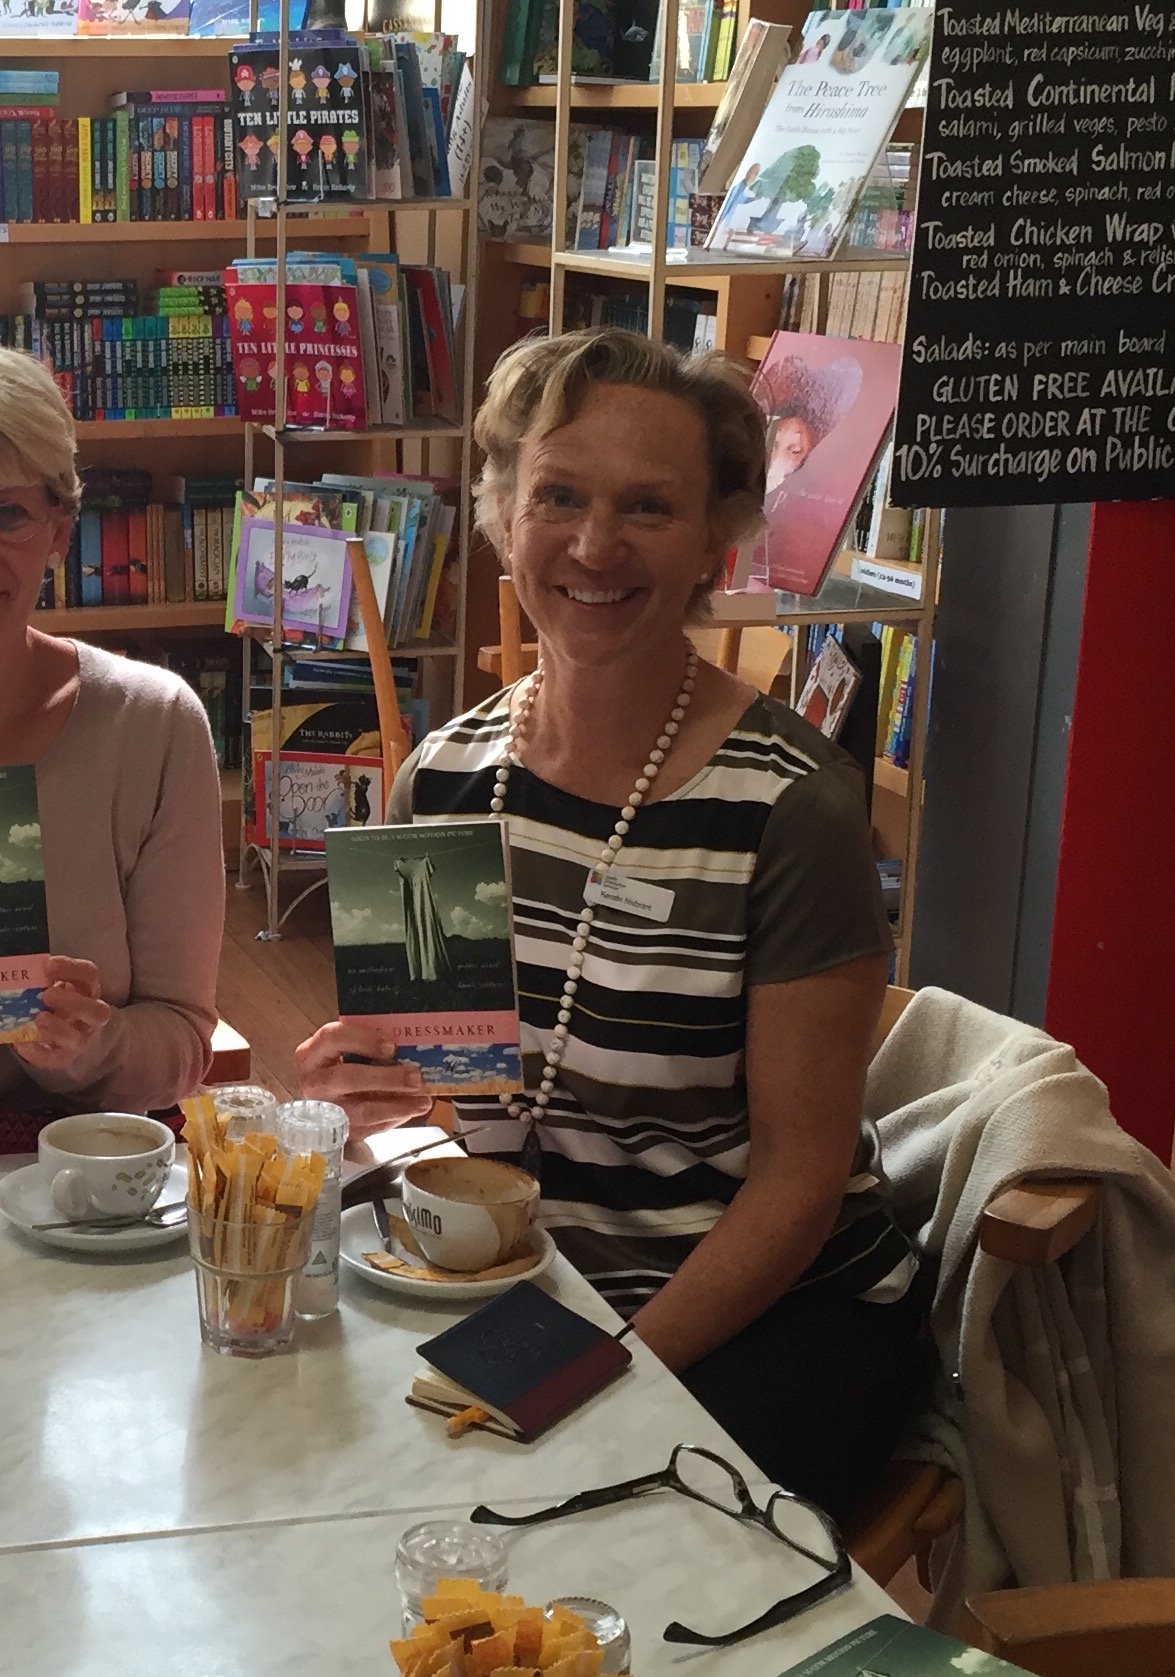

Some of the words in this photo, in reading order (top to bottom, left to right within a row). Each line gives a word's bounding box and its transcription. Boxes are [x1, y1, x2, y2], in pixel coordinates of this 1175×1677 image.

[937, 7, 1000, 36] Toasted
[1004, 8, 1129, 35] Mediterranean
[1135, 4, 1164, 37] Veg
[942, 41, 1018, 72] eggplant,
[1024, 42, 1047, 63] red
[1050, 42, 1121, 66] capsicum,
[788, 80, 812, 97] The
[815, 80, 853, 97] Peace
[857, 80, 887, 97] Tree
[933, 78, 1013, 109] Toasted
[1027, 73, 1155, 108] Continental
[237, 112, 262, 126] TEN
[310, 110, 359, 125] PIRATES
[803, 101, 869, 118] Hiroshima
[939, 112, 1002, 140] salami,
[1009, 112, 1065, 142] grilled
[1127, 112, 1168, 138] pesto
[925, 152, 1003, 181] Toasted
[1011, 149, 1078, 176] Smoked
[1091, 143, 1166, 172] Salmon
[941, 188, 994, 208] cream
[1002, 185, 1058, 207] cheese,
[1137, 181, 1162, 200] red
[921, 221, 995, 249] Toasted
[1010, 217, 1093, 245] Chicken
[1105, 211, 1164, 247] Wrap
[962, 249, 988, 269] red
[994, 249, 1045, 270] onion,
[1053, 246, 1114, 275] spinach
[1123, 249, 1137, 266] &
[921, 270, 1000, 300] Toasted
[1006, 268, 1053, 298] Ham
[1058, 280, 1072, 295] &
[1076, 265, 1143, 297] Cheese
[237, 343, 257, 354] TEN
[300, 343, 357, 357] PRINCESSES
[912, 332, 990, 364] Salads:
[994, 340, 1018, 360] as
[1023, 340, 1053, 367] per
[1061, 333, 1106, 357] main
[1118, 329, 1166, 354] board
[933, 373, 1018, 403] GLUTEN
[1033, 371, 1090, 400] FREE
[916, 412, 996, 442] PLEASE
[1002, 410, 1071, 438] ORDER
[1076, 407, 1106, 436] AT
[1112, 405, 1152, 435] THE
[895, 443, 942, 482] 10%
[950, 443, 1063, 482] Surcharge
[1067, 447, 1097, 473] on
[1105, 435, 1175, 472] Public
[300, 728, 316, 737] THE
[318, 729, 353, 739] RABBITS
[279, 775, 314, 797] Open
[393, 1025, 497, 1038] DRESSMAKER
